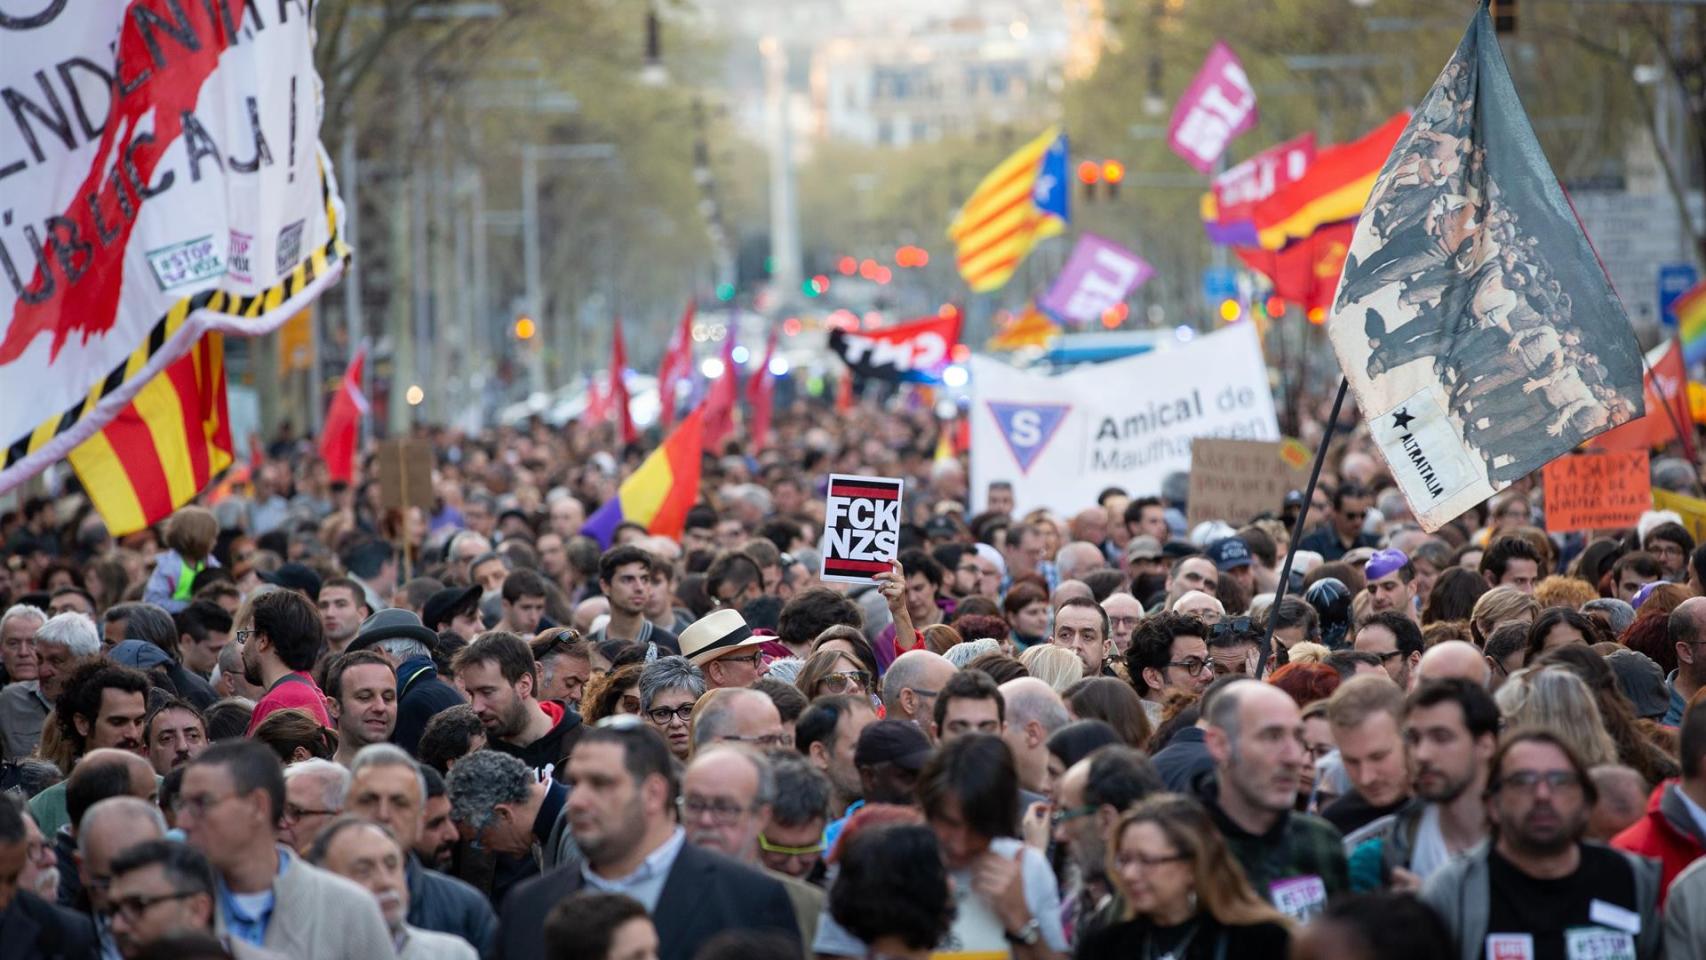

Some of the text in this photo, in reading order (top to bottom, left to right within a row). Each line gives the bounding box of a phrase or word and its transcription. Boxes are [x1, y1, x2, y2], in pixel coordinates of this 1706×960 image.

[1010, 409, 1043, 447] S
[1096, 383, 1255, 441] Amical de
[1400, 432, 1444, 500] ALTRAITALIA
[828, 496, 899, 531] FCK
[824, 526, 897, 563] NZS
